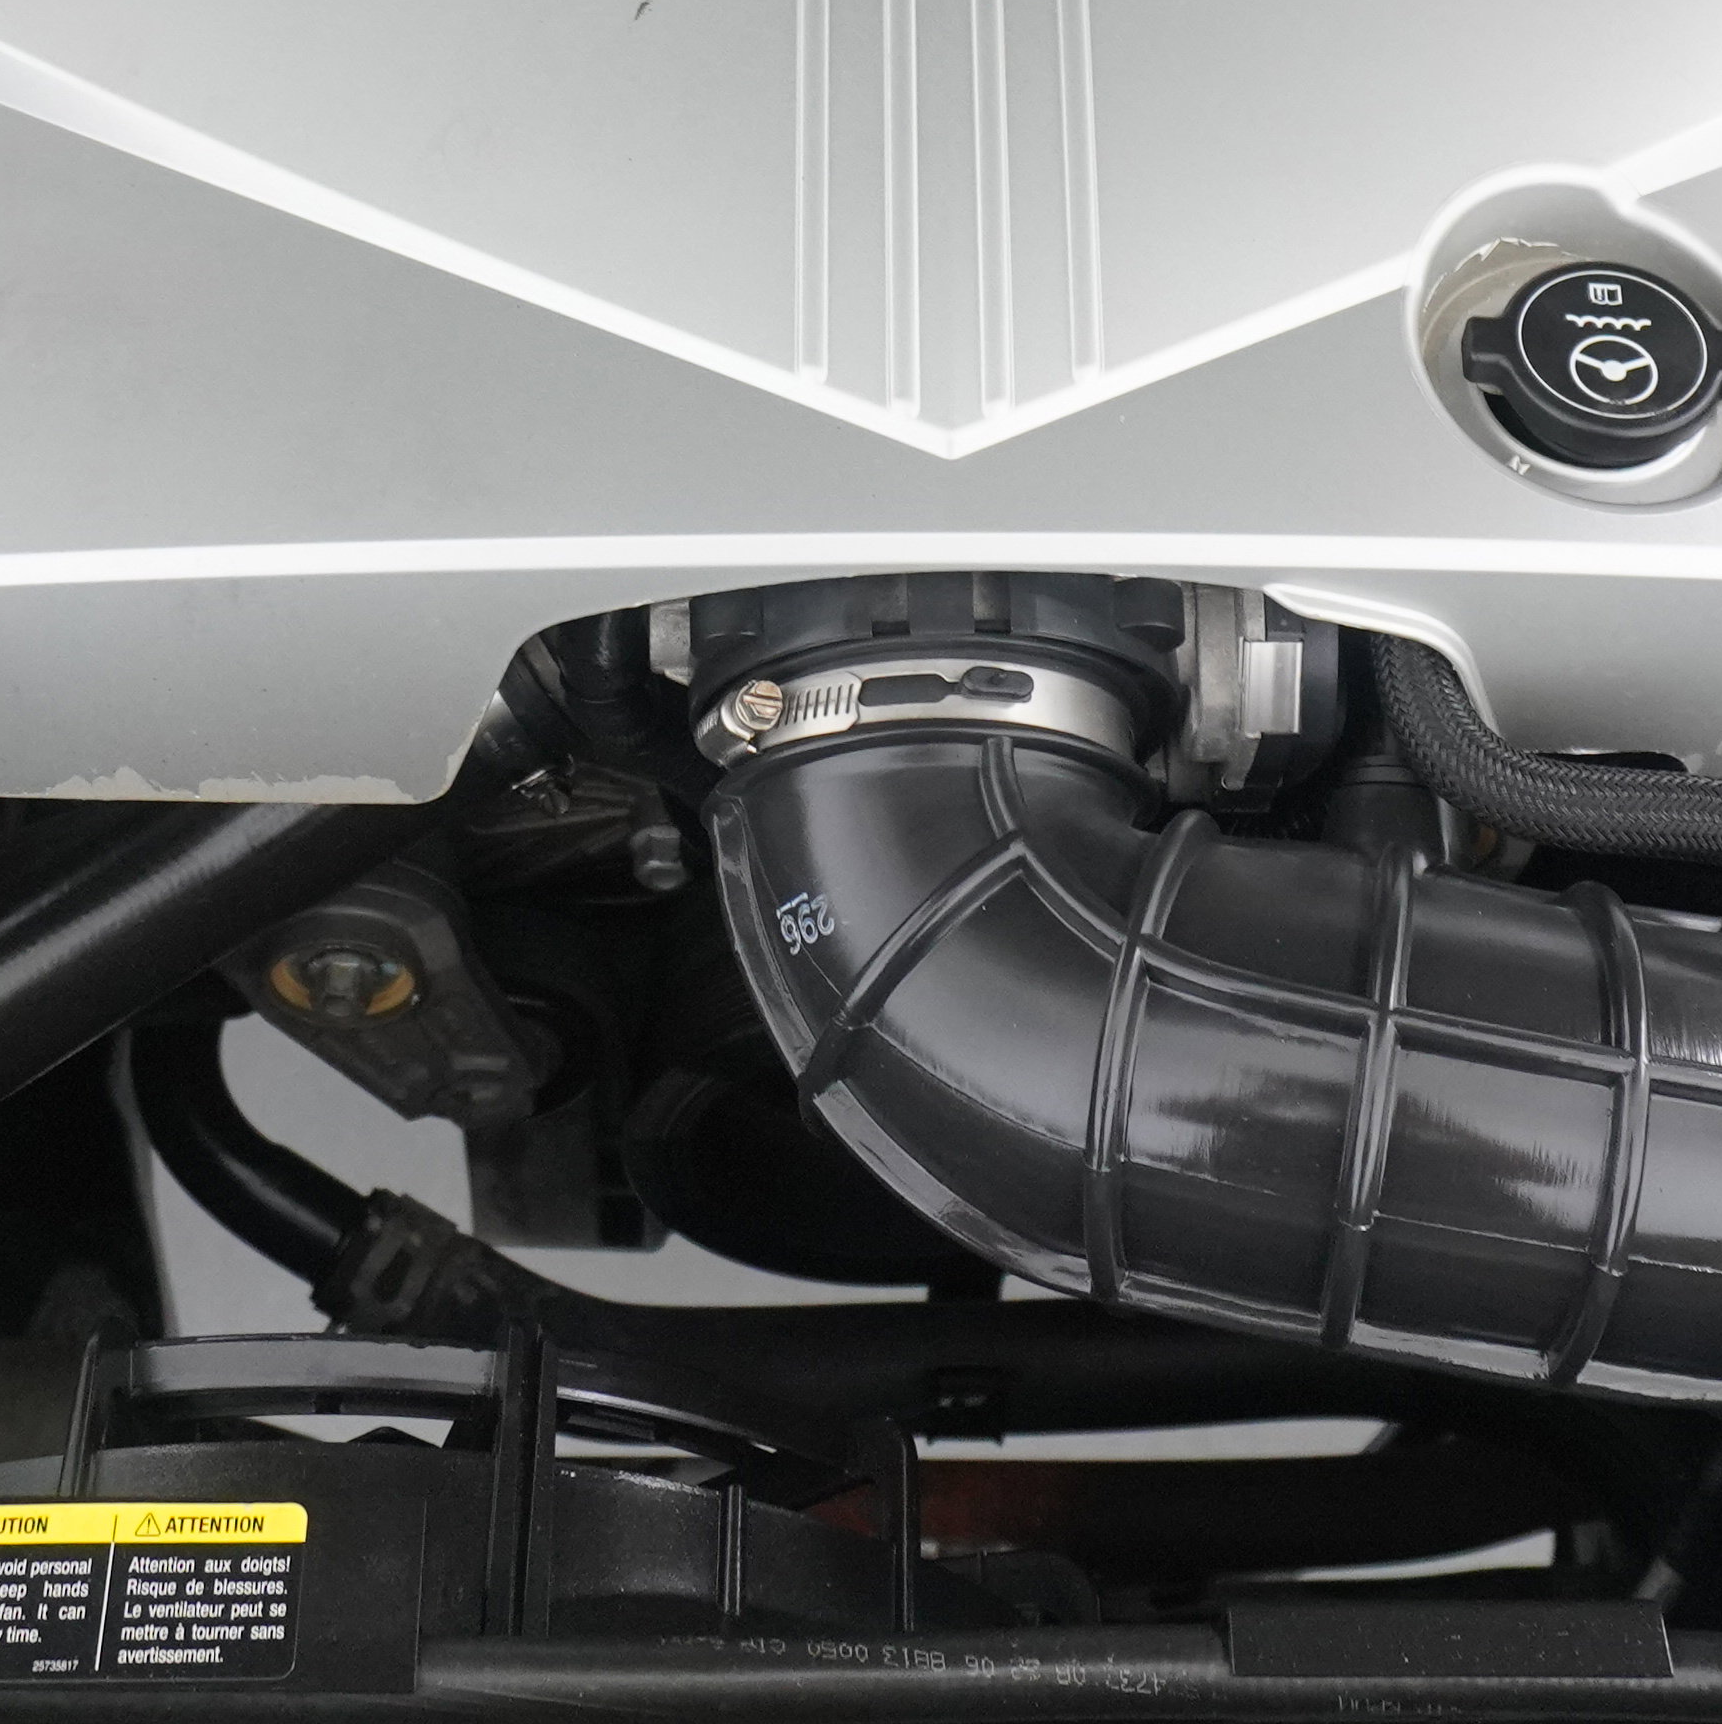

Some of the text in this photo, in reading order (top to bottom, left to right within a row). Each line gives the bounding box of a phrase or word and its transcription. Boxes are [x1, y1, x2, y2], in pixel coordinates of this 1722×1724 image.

[164, 1516, 265, 1533] ATTENTION
[30, 1558, 92, 1578] personal
[129, 1556, 290, 1576] Attention aux doigts!
[43, 1580, 88, 1598] hands
[127, 1578, 287, 1598] Risque de blessures.
[0, 1603, 25, 1620] fan.
[38, 1603, 48, 1620] It
[59, 1606, 85, 1620] can
[124, 1601, 286, 1620] Le ventilateur peut se
[7, 1626, 41, 1643] time.
[121, 1623, 284, 1641] mettre à tourner sans
[118, 1646, 223, 1664] avertissement.
